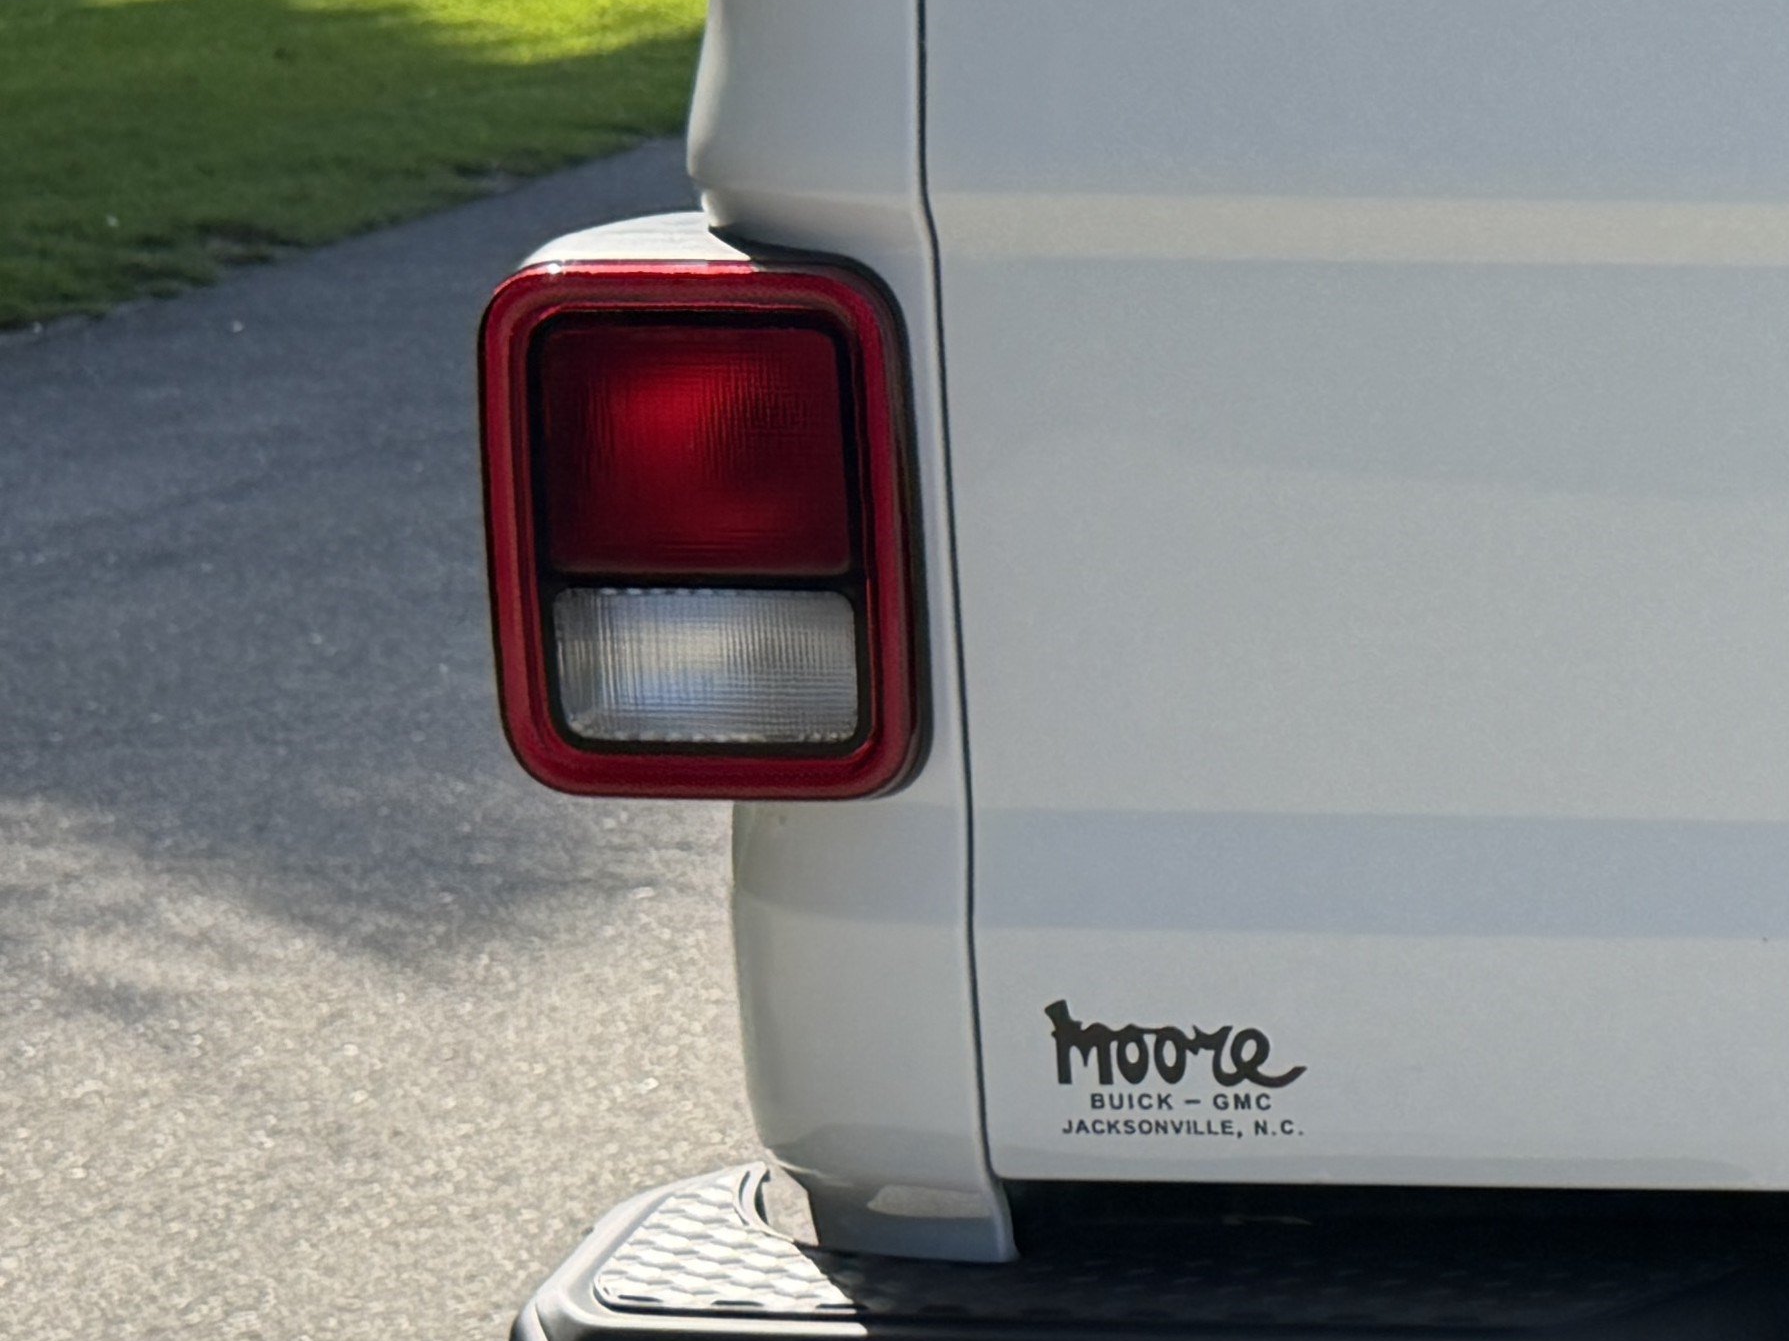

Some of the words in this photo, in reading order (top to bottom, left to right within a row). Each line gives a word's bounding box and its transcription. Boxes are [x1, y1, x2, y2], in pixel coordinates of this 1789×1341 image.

[1090, 1092, 1174, 1111] BUICK
[1212, 1092, 1272, 1111] GMC
[1062, 1119, 1243, 1139] JACKSONVILLE,
[1254, 1119, 1304, 1136] N.C.
